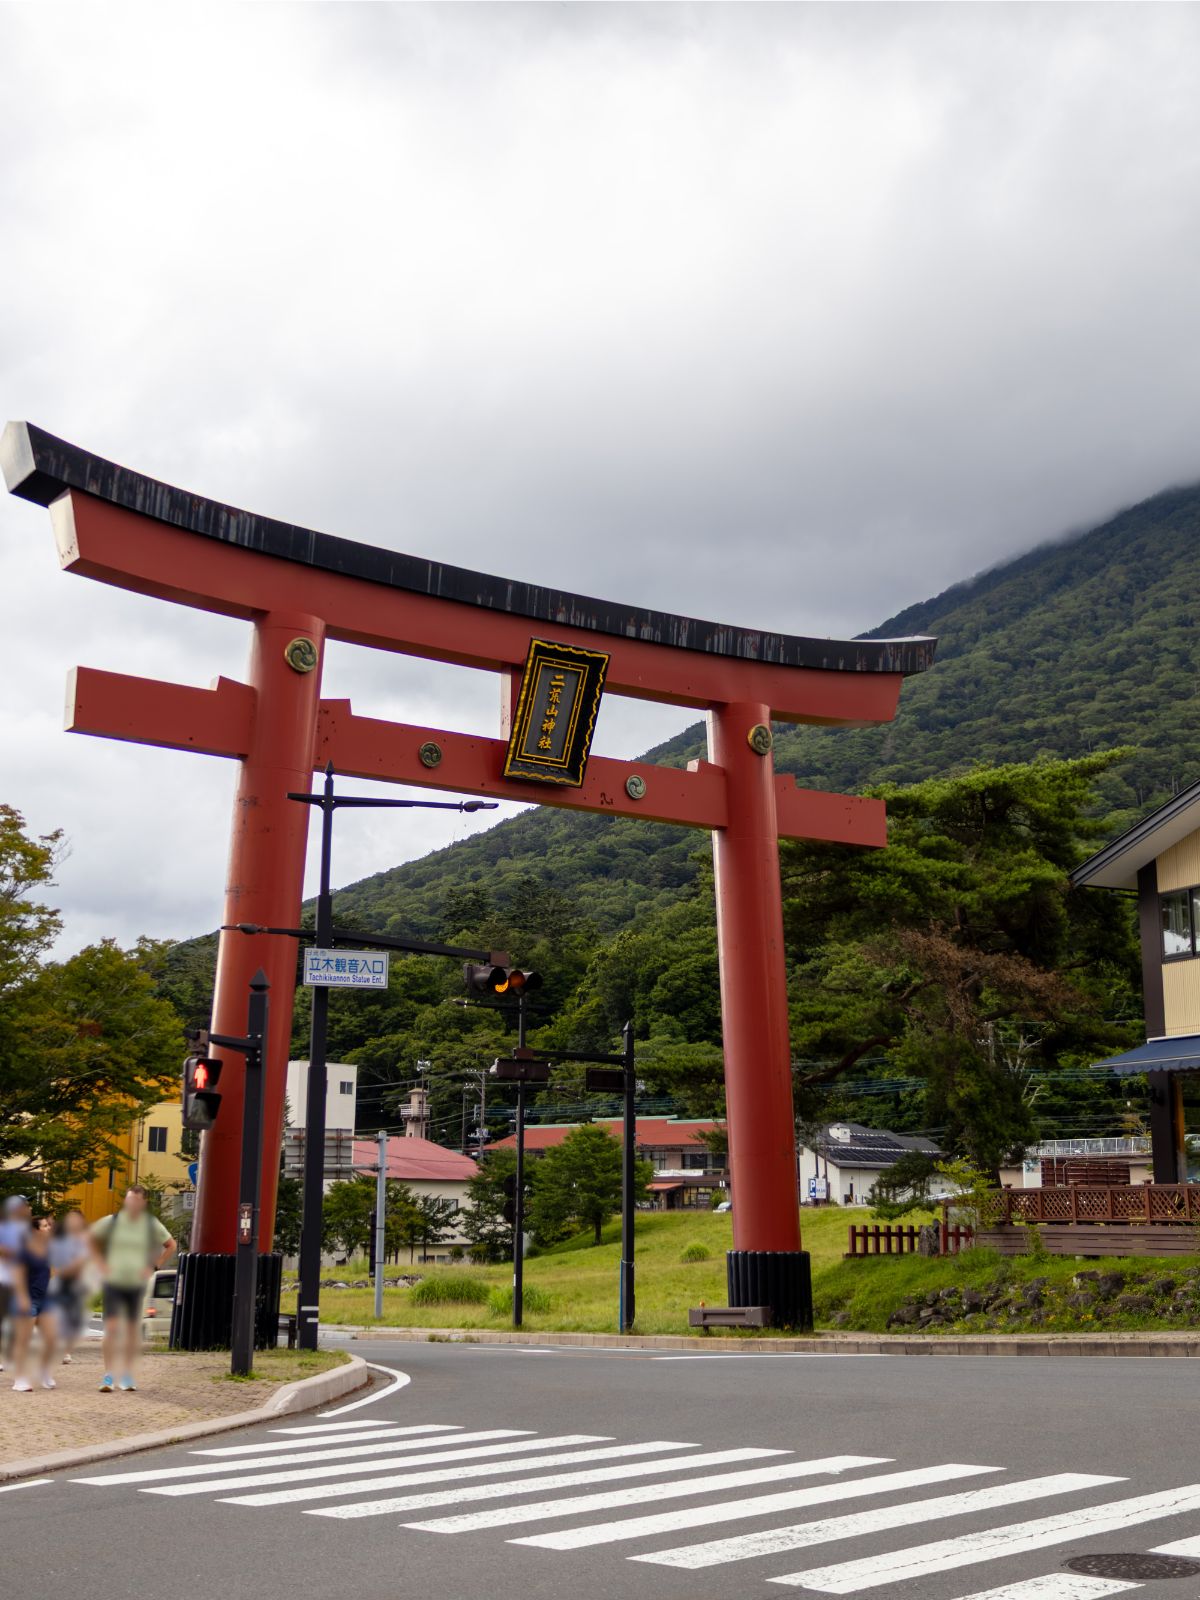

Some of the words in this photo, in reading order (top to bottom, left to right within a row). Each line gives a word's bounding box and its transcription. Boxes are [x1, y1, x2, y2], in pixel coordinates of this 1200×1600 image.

[309, 957, 384, 974] 立木観音入口
[309, 973, 350, 982] Tachikikannon
[352, 975, 370, 983] Statue
